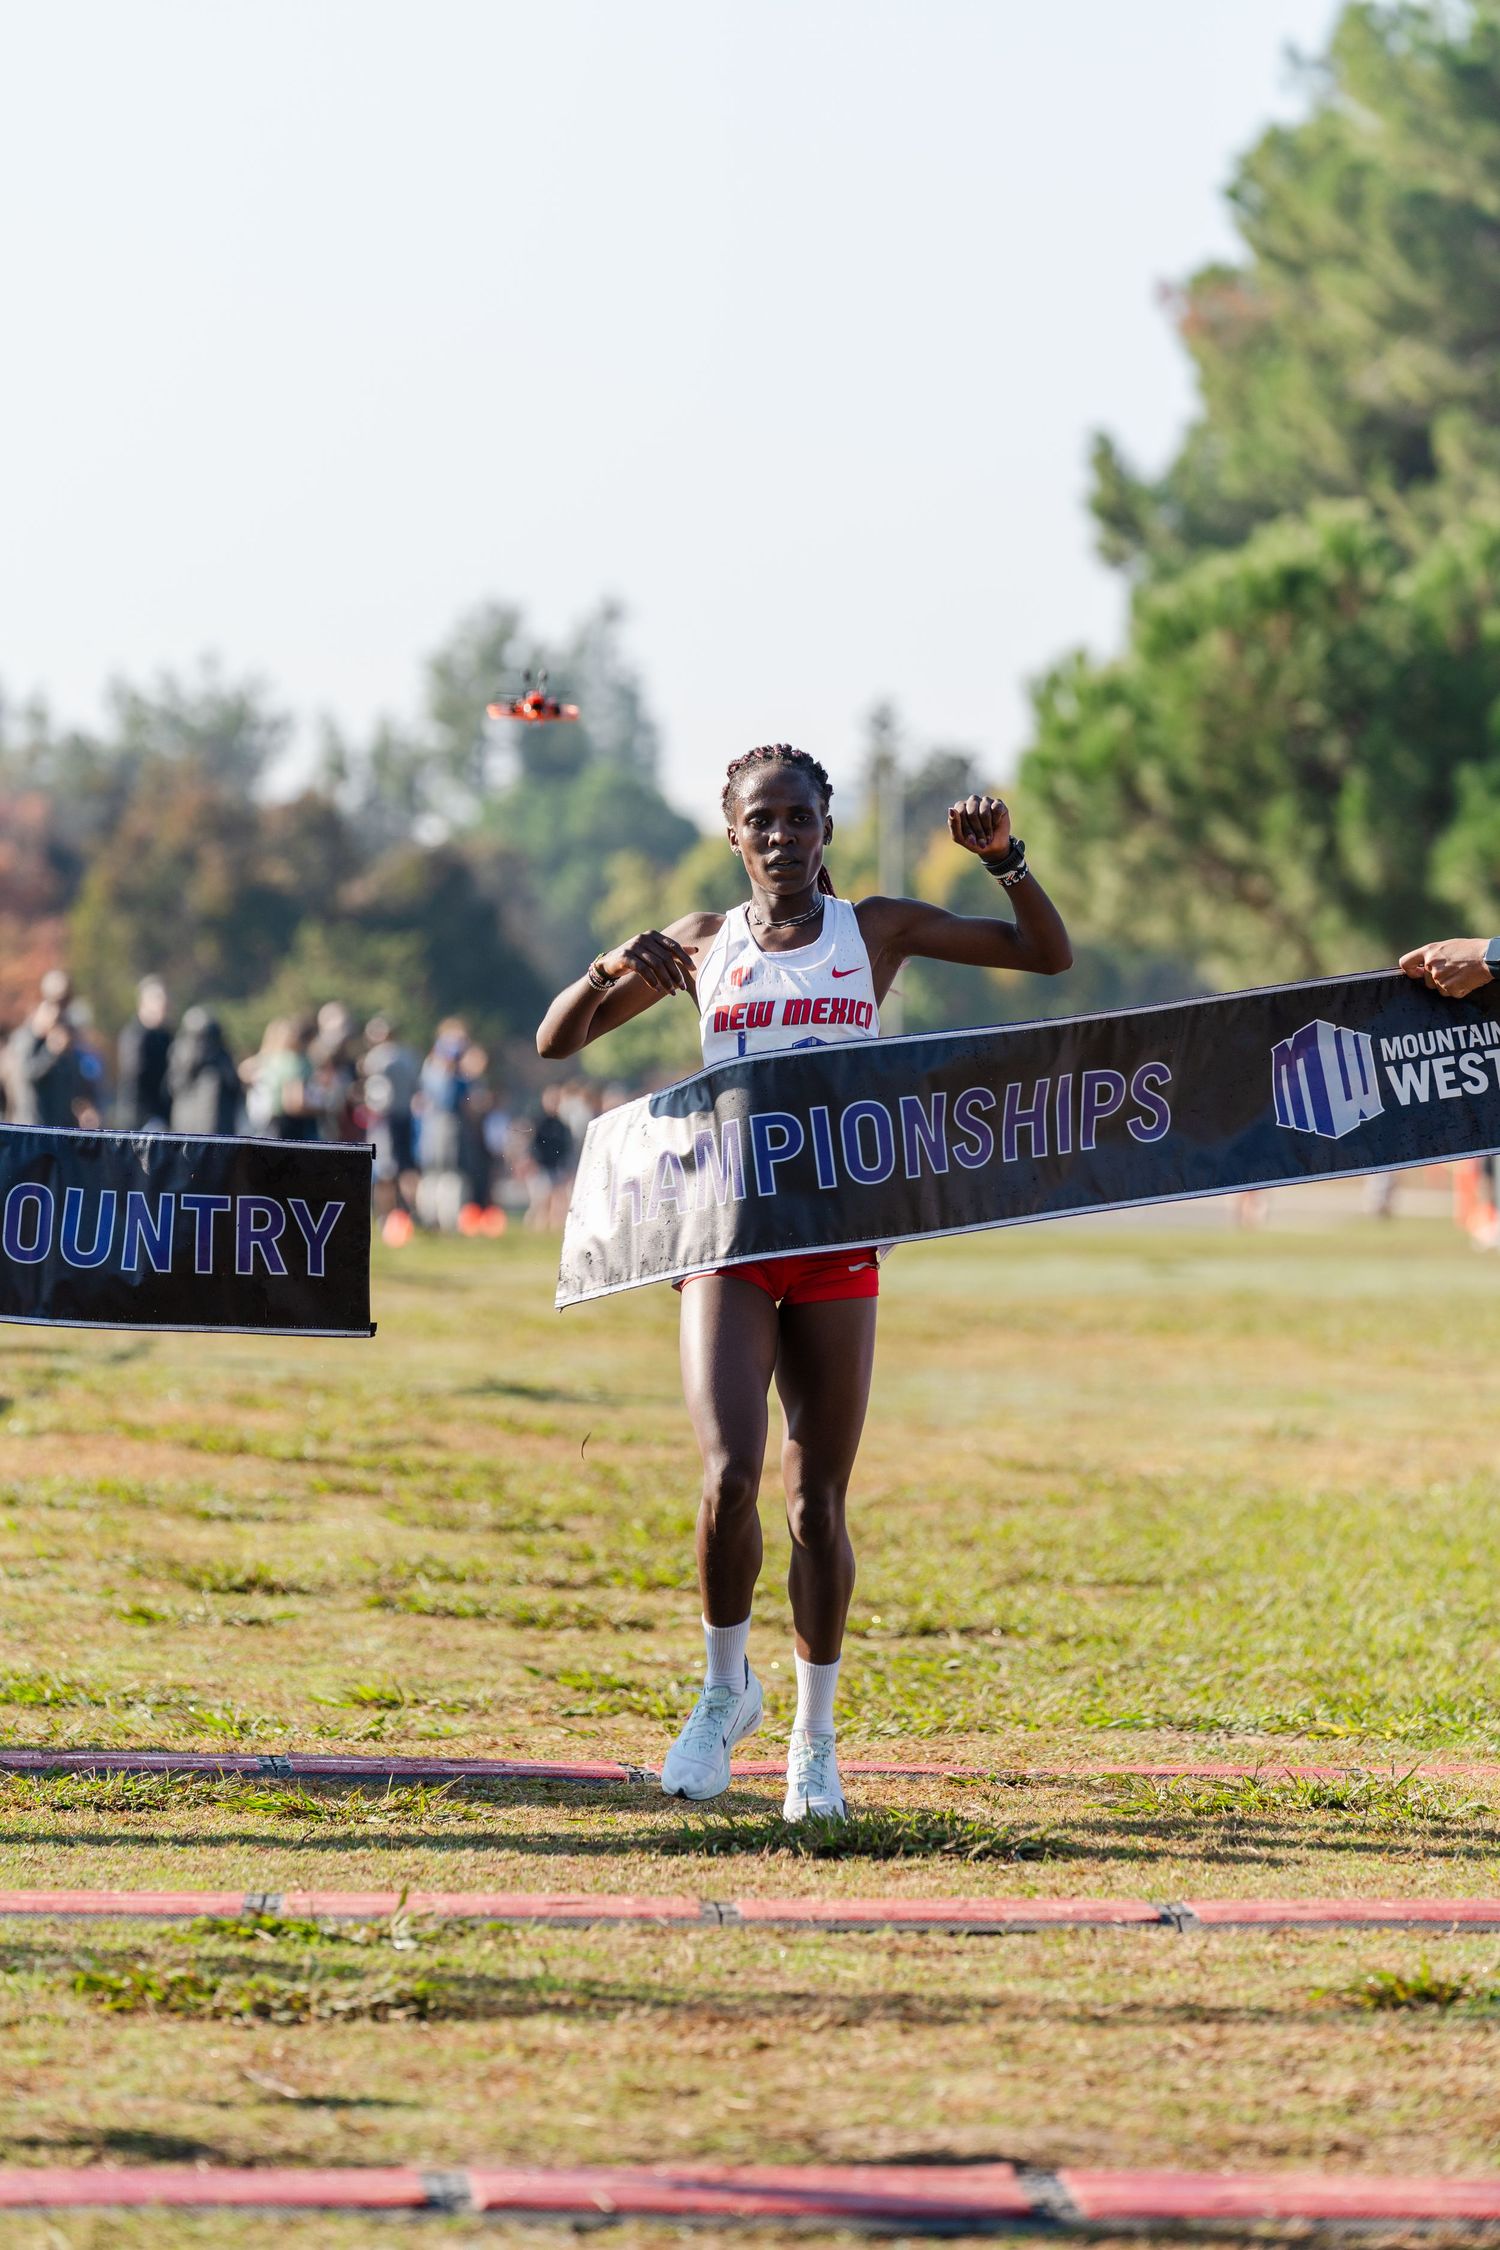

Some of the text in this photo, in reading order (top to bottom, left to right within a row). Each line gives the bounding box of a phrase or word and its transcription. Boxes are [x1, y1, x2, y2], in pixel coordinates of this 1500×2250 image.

[713, 997, 873, 1033] NEW MEXICO
[1380, 1020, 1500, 1062] MOUNTAIN
[1385, 1048, 1500, 1106] WEST
[592, 1061, 1172, 1233] HAMPIONSHIPS
[2, 1182, 346, 1277] OUNTRY
